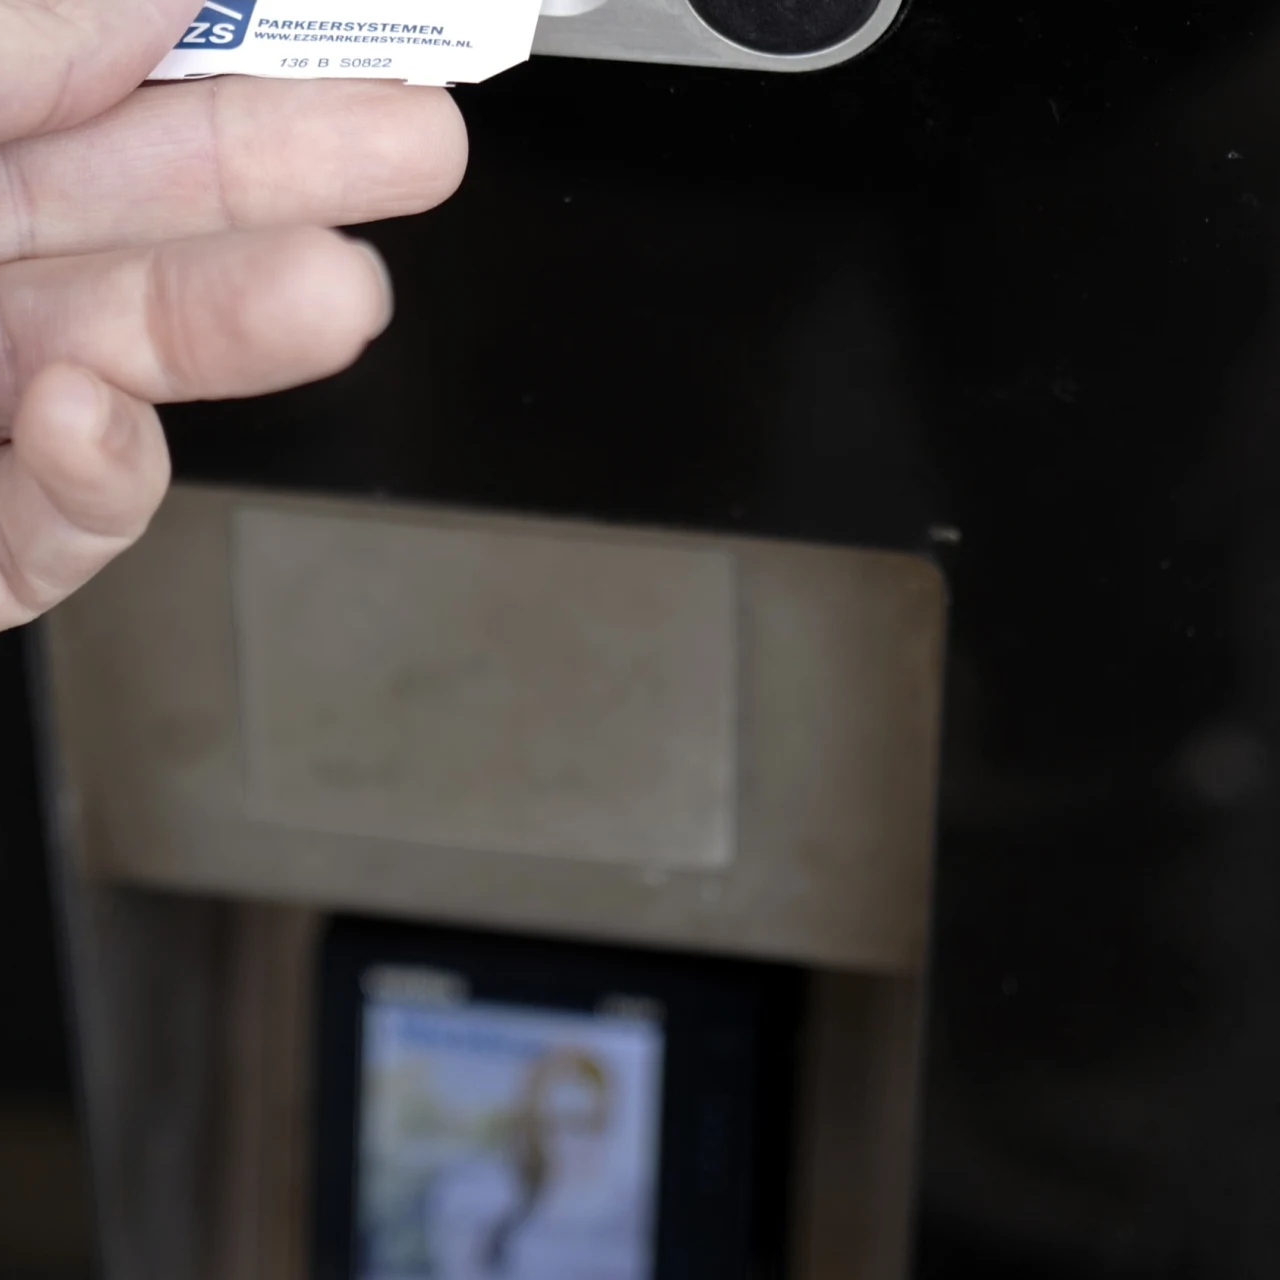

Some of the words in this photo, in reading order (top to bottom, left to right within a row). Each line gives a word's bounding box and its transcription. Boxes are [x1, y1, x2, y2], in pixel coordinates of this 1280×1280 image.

[182, 22, 236, 44] ZS
[257, 18, 444, 36] PARKEERSYSTEMEN
[254, 32, 474, 48] WWW.EZSPARKEERSYSTEMEN.NL
[279, 57, 310, 69] 136
[317, 57, 330, 68] B
